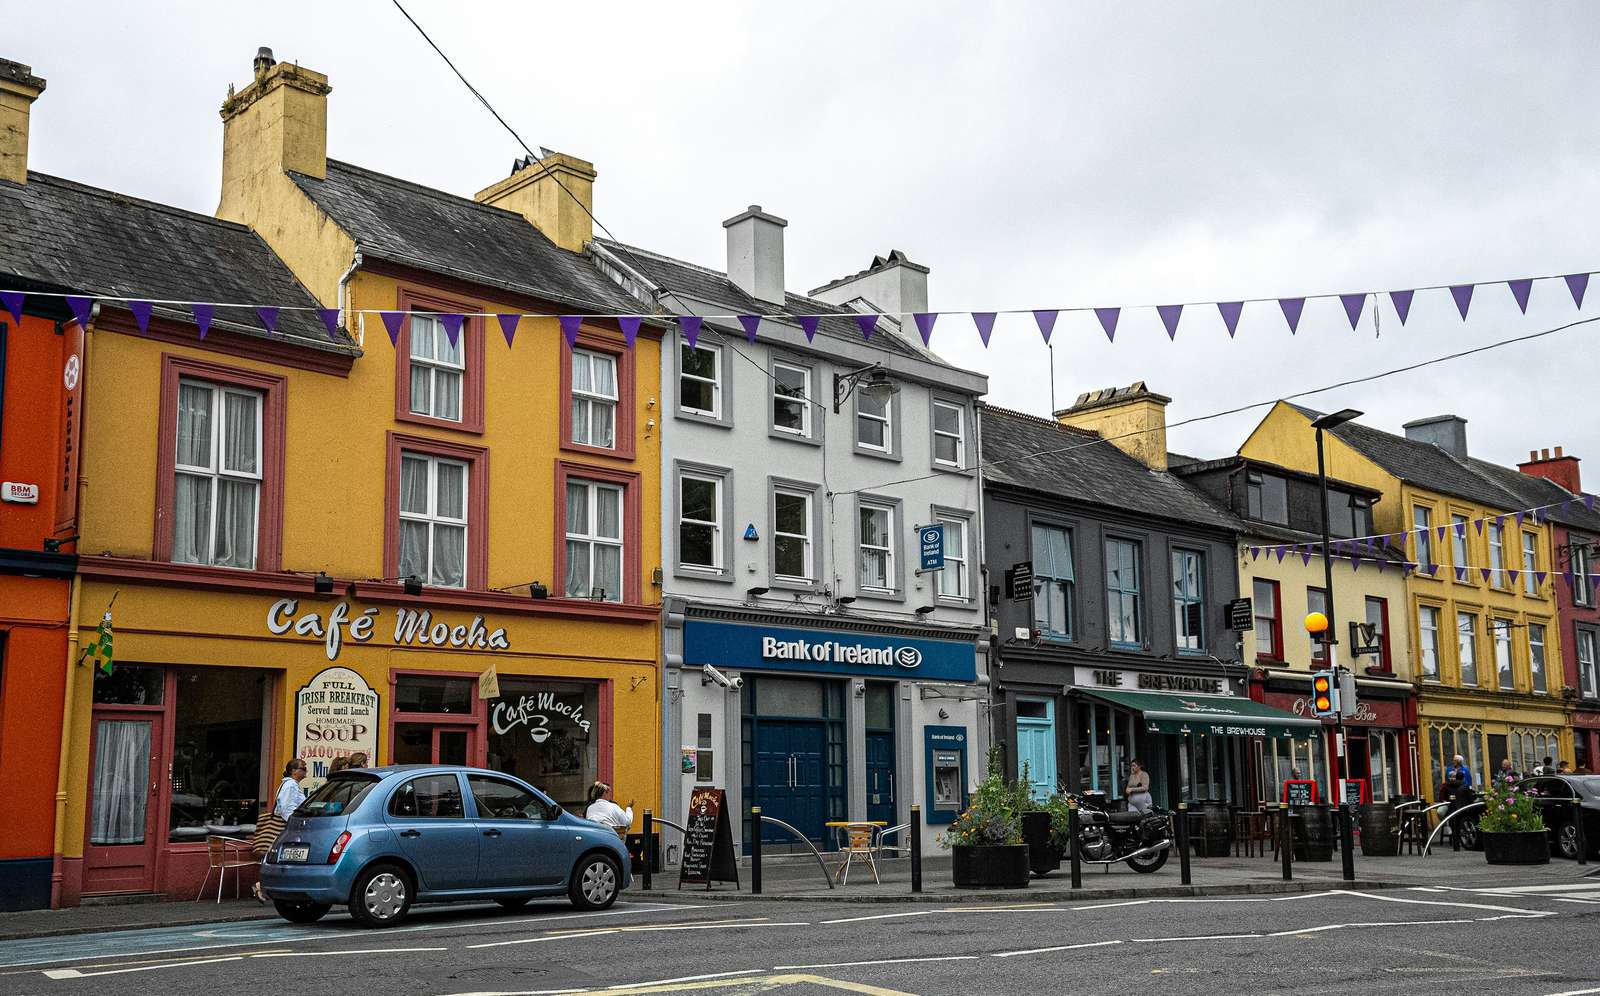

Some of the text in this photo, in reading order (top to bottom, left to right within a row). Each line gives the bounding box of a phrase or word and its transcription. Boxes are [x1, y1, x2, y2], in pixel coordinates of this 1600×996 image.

[10, 485, 31, 493] BBM
[923, 543, 935, 551] Bank
[266, 599, 511, 660] Café Mocha
[762, 636, 893, 666] Bank of Ireland
[322, 681, 355, 690] FULL
[1092, 670, 1224, 693] THE BREWHOUSE
[301, 690, 376, 708] IRISH BREAKFAST
[307, 705, 370, 716] Served until Lunch
[492, 692, 591, 735] Café Mocha
[1354, 702, 1377, 721] Bar
[1210, 725, 1266, 737] THE BREWHOUSE
